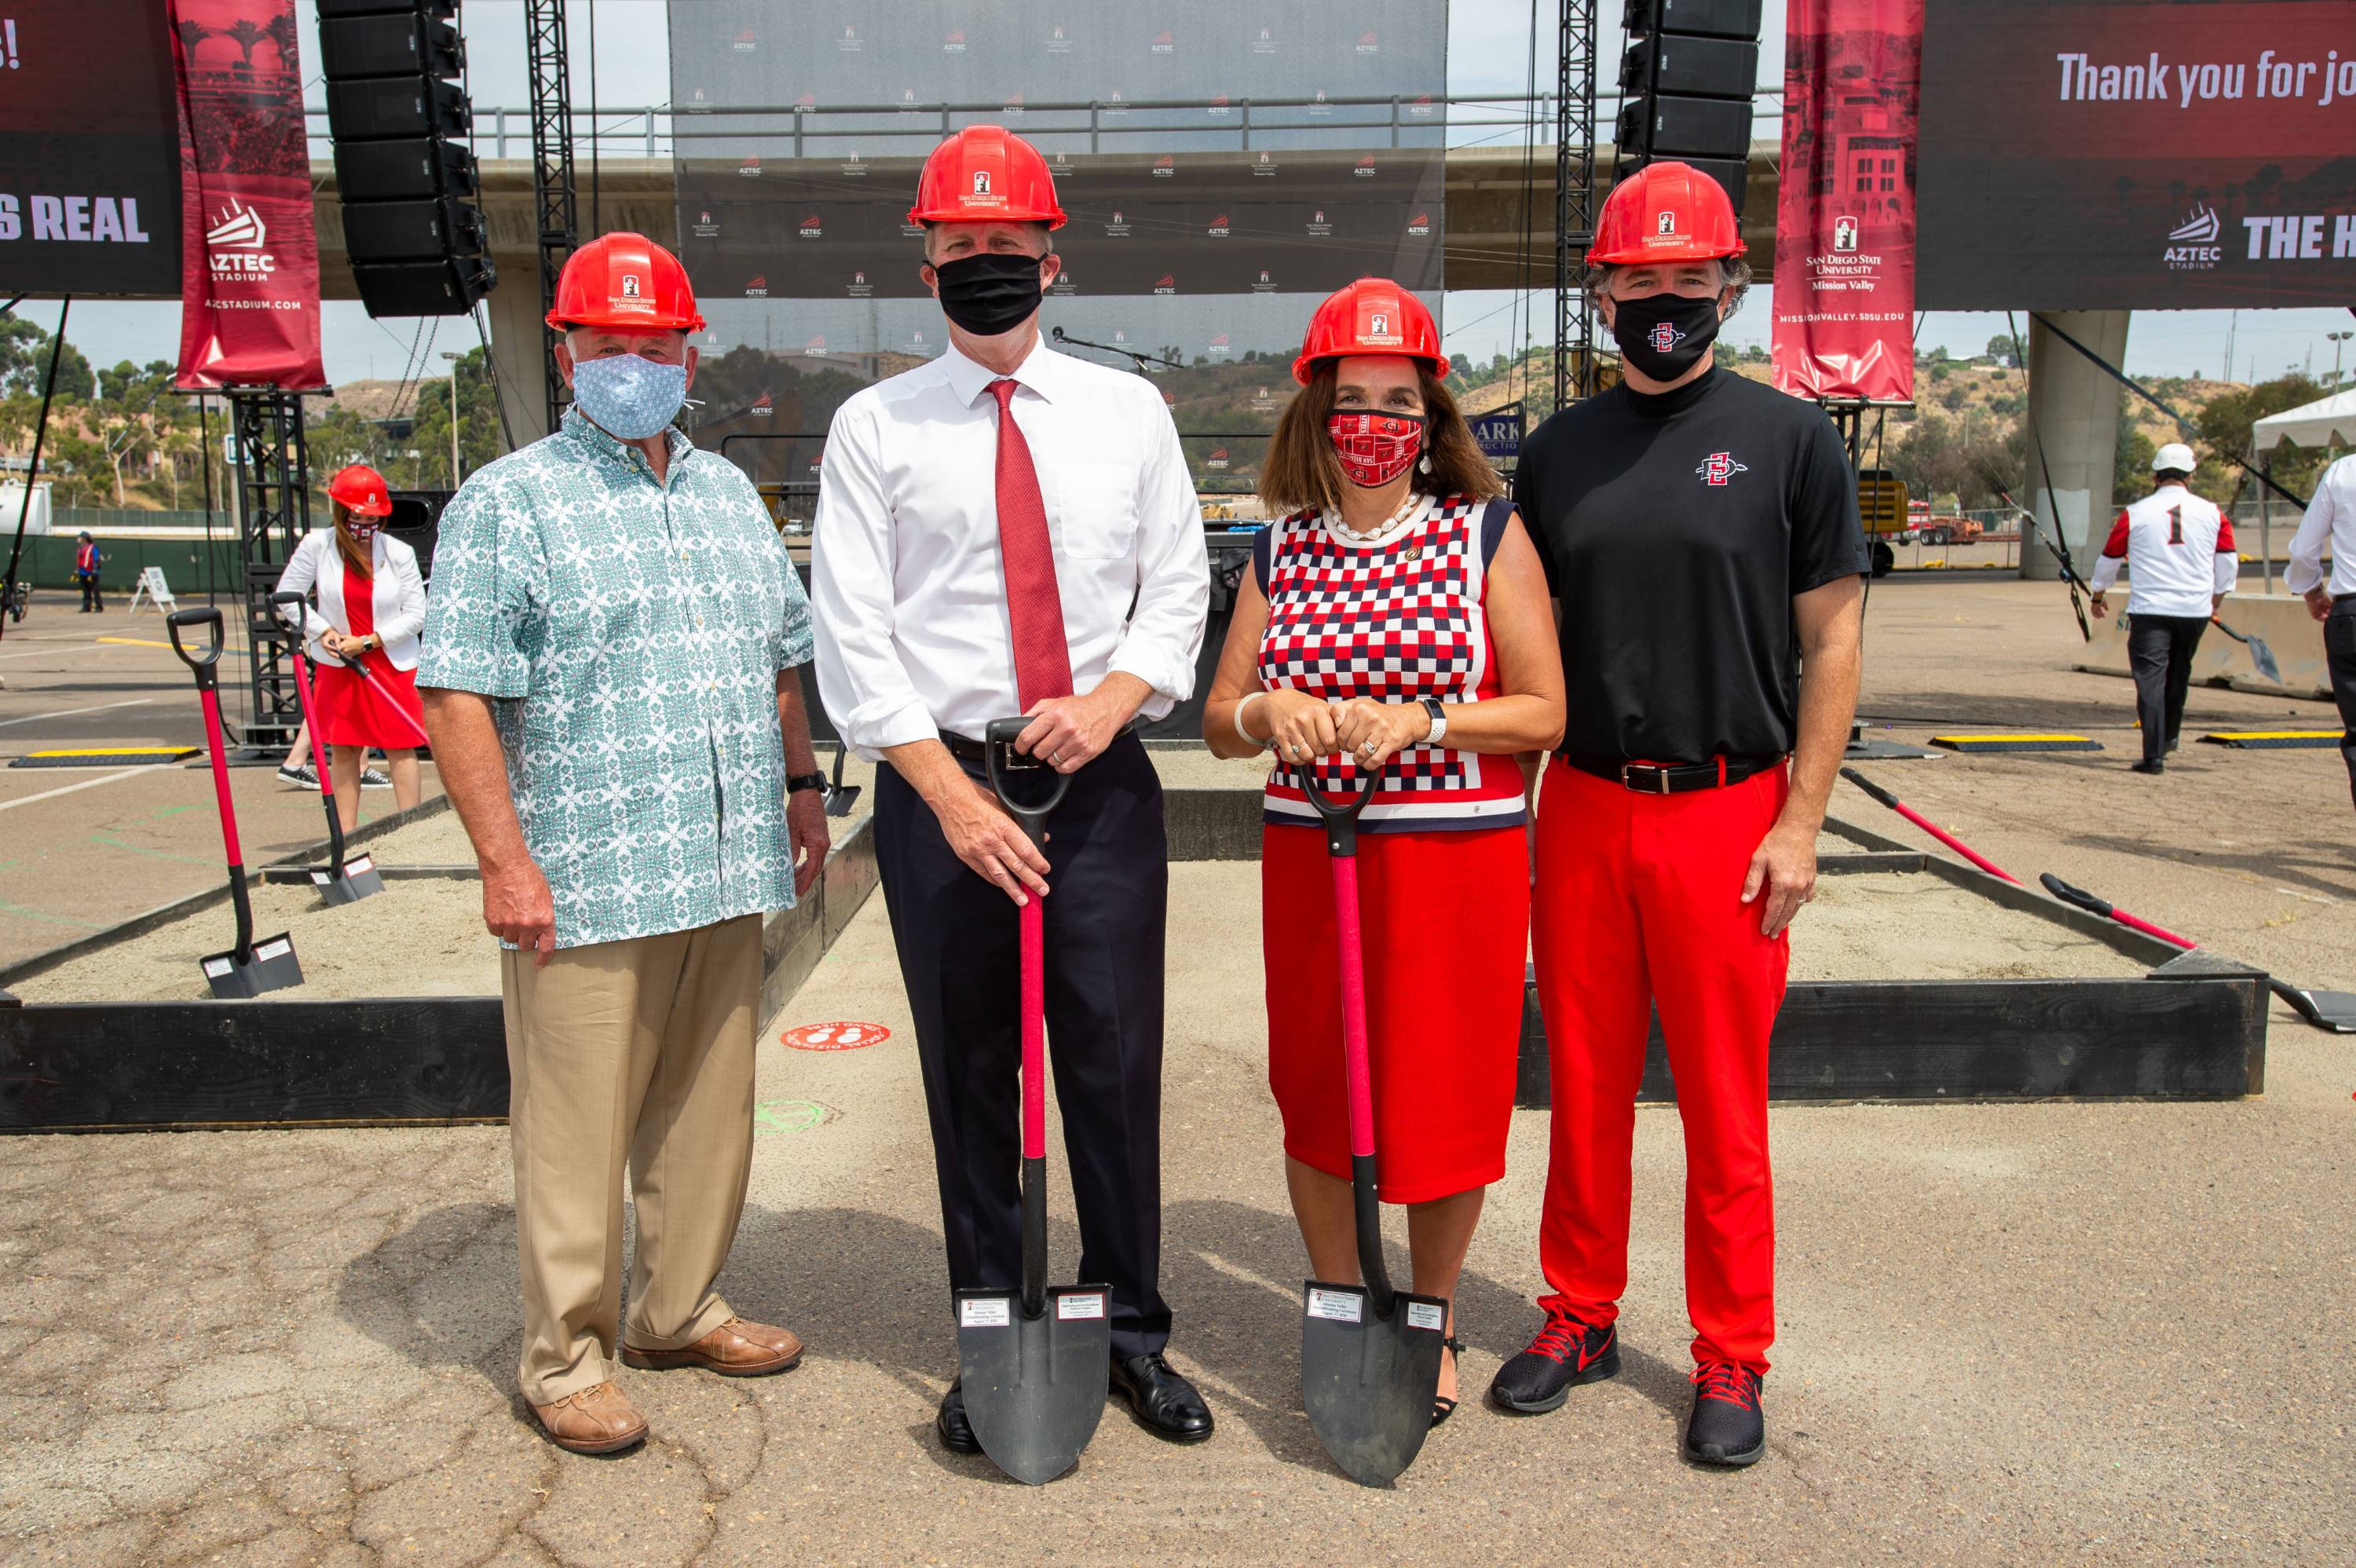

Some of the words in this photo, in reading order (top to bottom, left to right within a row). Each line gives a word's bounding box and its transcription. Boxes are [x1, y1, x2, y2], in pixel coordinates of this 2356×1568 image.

[2057, 52, 2169, 101] Thank
[2178, 64, 2245, 108] you
[2256, 49, 2316, 98] for
[31, 195, 149, 243] REAL
[2243, 215, 2325, 259] THE
[1806, 256, 1824, 266] SAN
[1827, 254, 1857, 265] DIEGO
[1859, 254, 1881, 265] STATE
[2164, 247, 2222, 261] AZTEC
[1816, 265, 1872, 275] UNIVERSITY
[211, 272, 268, 282] STADIUM
[1813, 281, 1846, 291] Mission
[1849, 280, 1875, 292] Valley
[1780, 313, 1904, 323] MISSIONVALLEY.SDSU.EDU
[2165, 503, 2186, 546] 1
